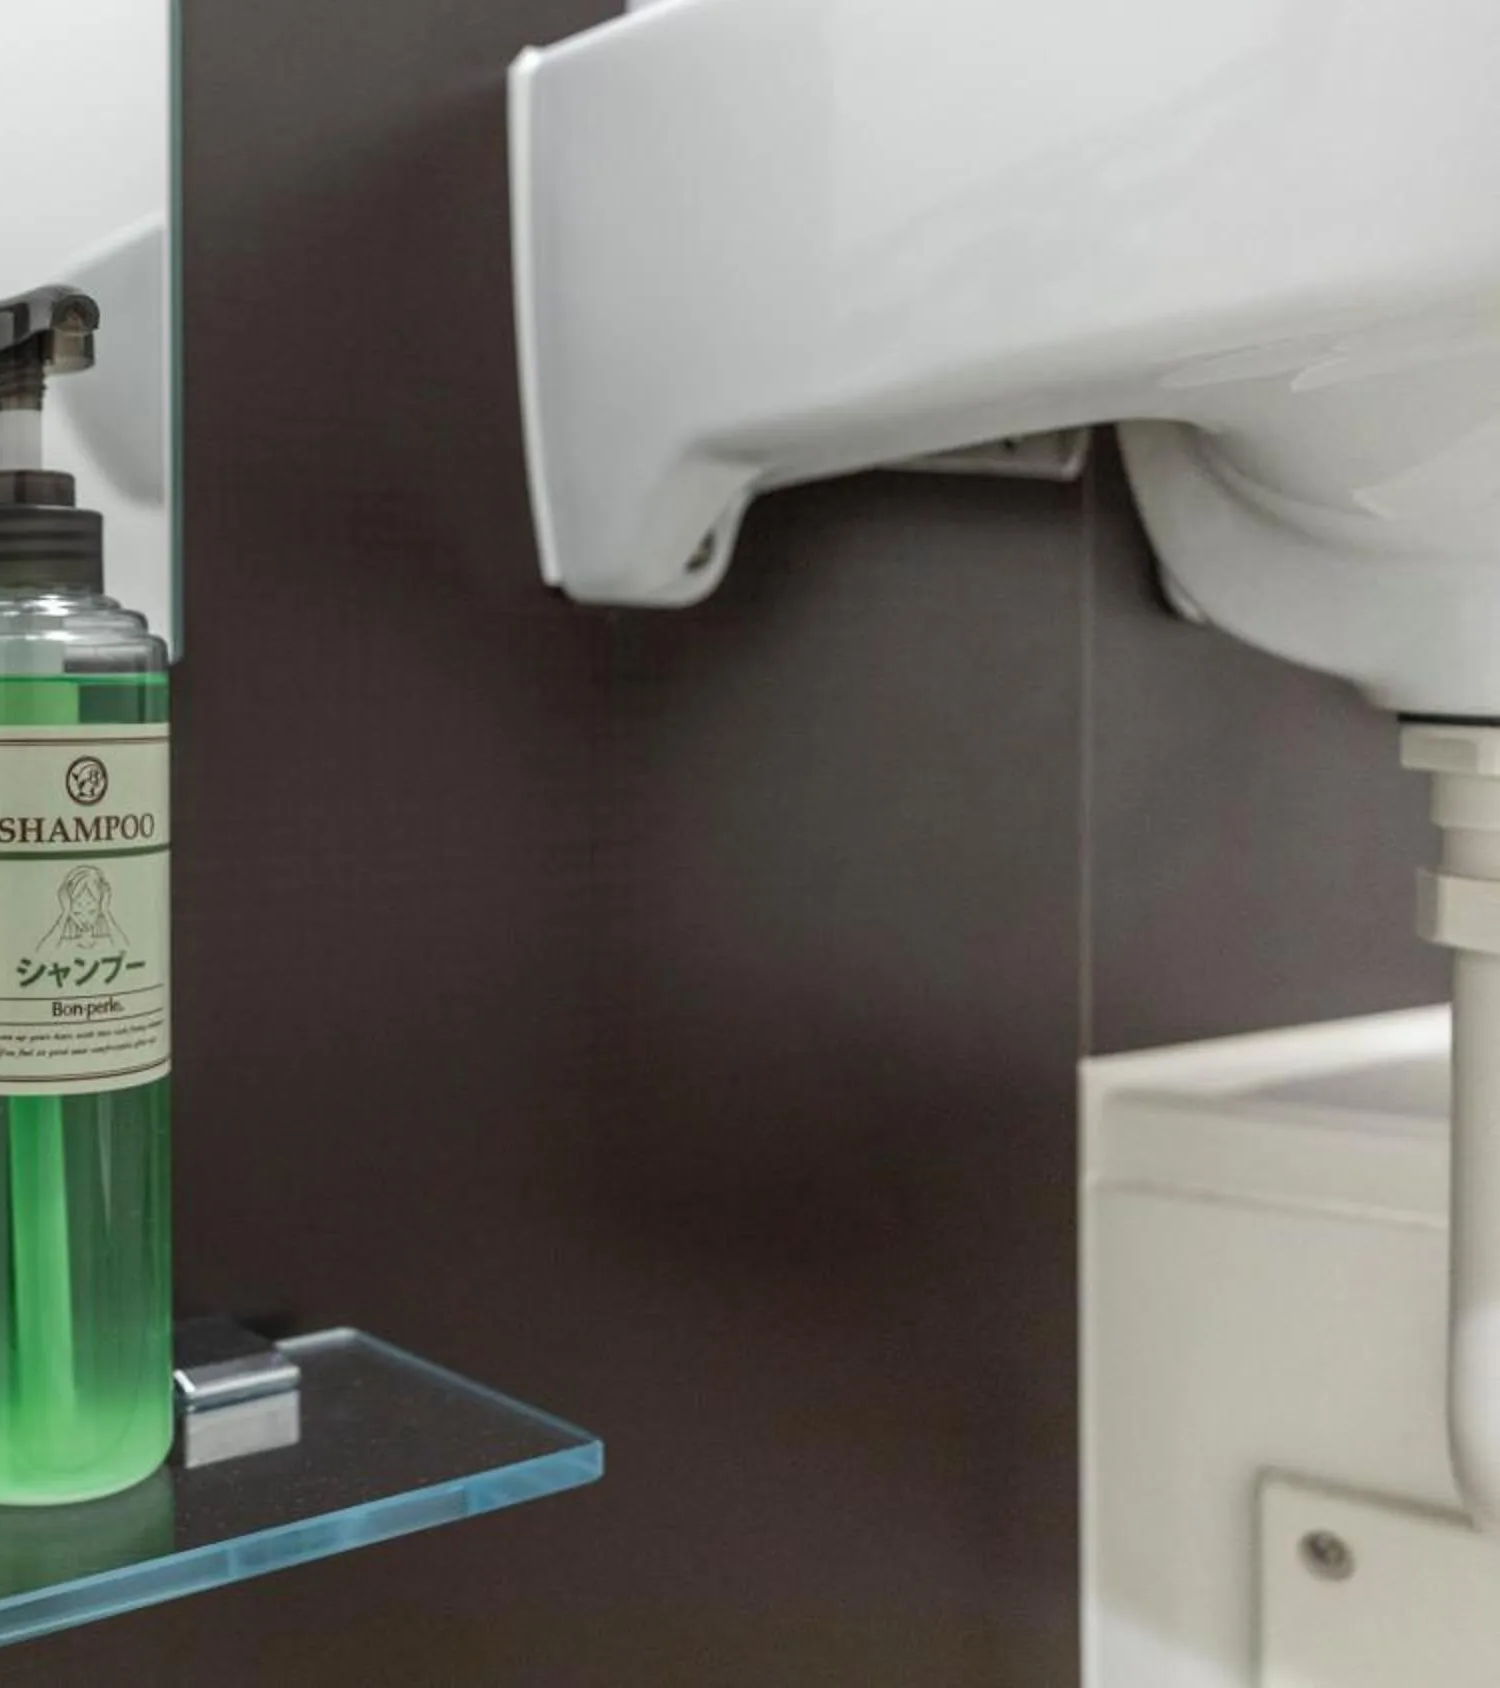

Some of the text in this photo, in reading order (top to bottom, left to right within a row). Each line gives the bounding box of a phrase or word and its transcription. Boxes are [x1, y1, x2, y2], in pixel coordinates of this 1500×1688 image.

[16, 949, 146, 988] シャンプー
